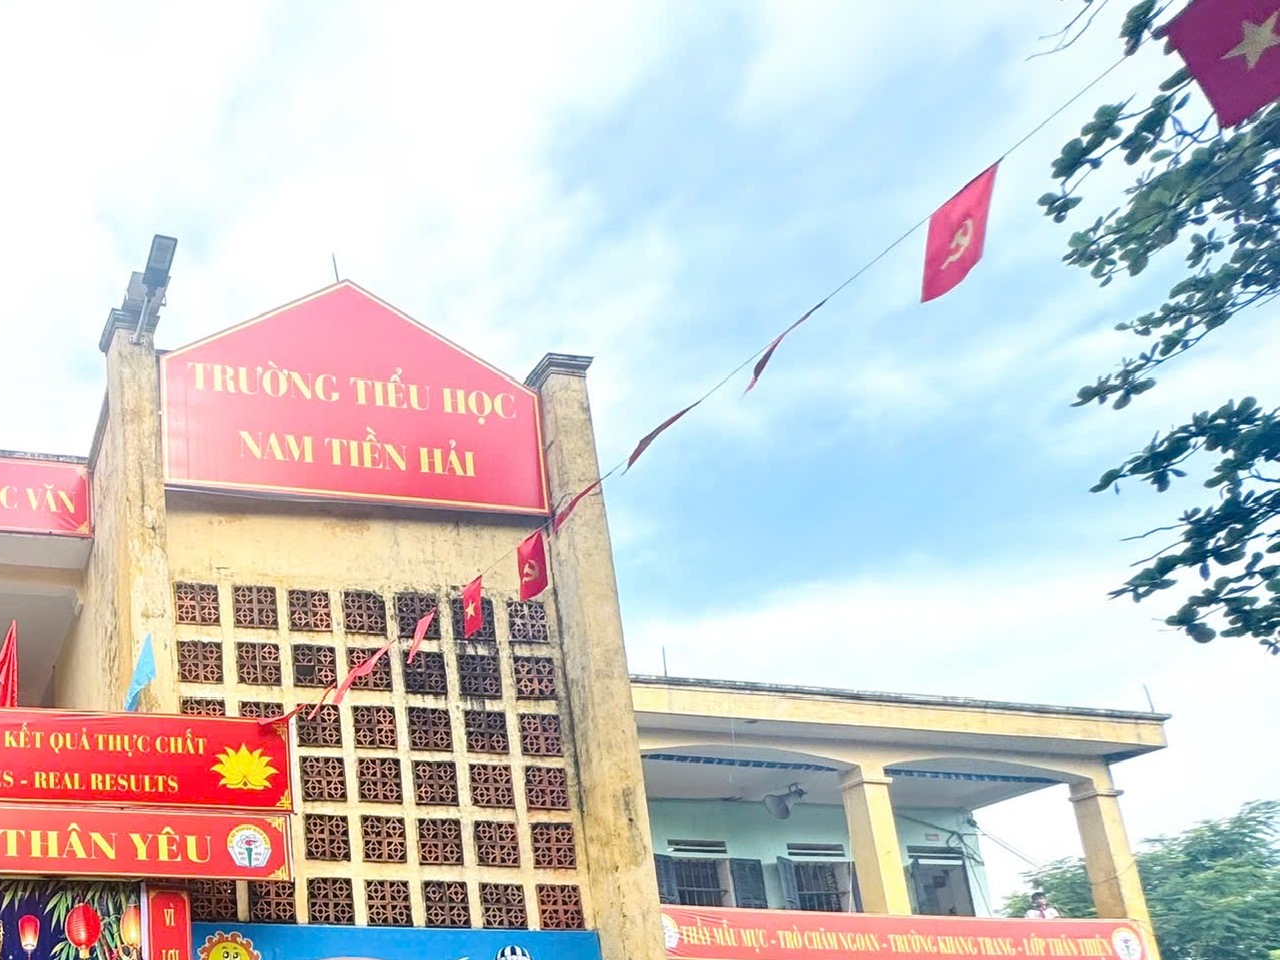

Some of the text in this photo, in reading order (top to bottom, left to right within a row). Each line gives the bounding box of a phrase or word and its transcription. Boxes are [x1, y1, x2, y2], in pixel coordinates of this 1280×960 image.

[187, 360, 517, 425] TRƯỜNG TIỂU HỌC
[239, 427, 476, 477] NAM TIỀN HẢI
[26, 483, 76, 514] VĂN
[4, 722, 45, 749] KẾT
[49, 727, 91, 754] QUẢ
[94, 732, 151, 758] THỰC
[155, 728, 207, 755] CHẤT
[34, 771, 85, 790] REAL
[91, 773, 179, 793] RESULTS
[129, 826, 212, 863] YÊU
[163, 903, 176, 927] VÌ
[740, 928, 768, 953] MỰC
[777, 926, 803, 949] TRÒ
[804, 928, 837, 950] CHĂM
[837, 930, 880, 952] NGOAN
[937, 935, 977, 956] KHANG
[979, 936, 1015, 957] TRANG
